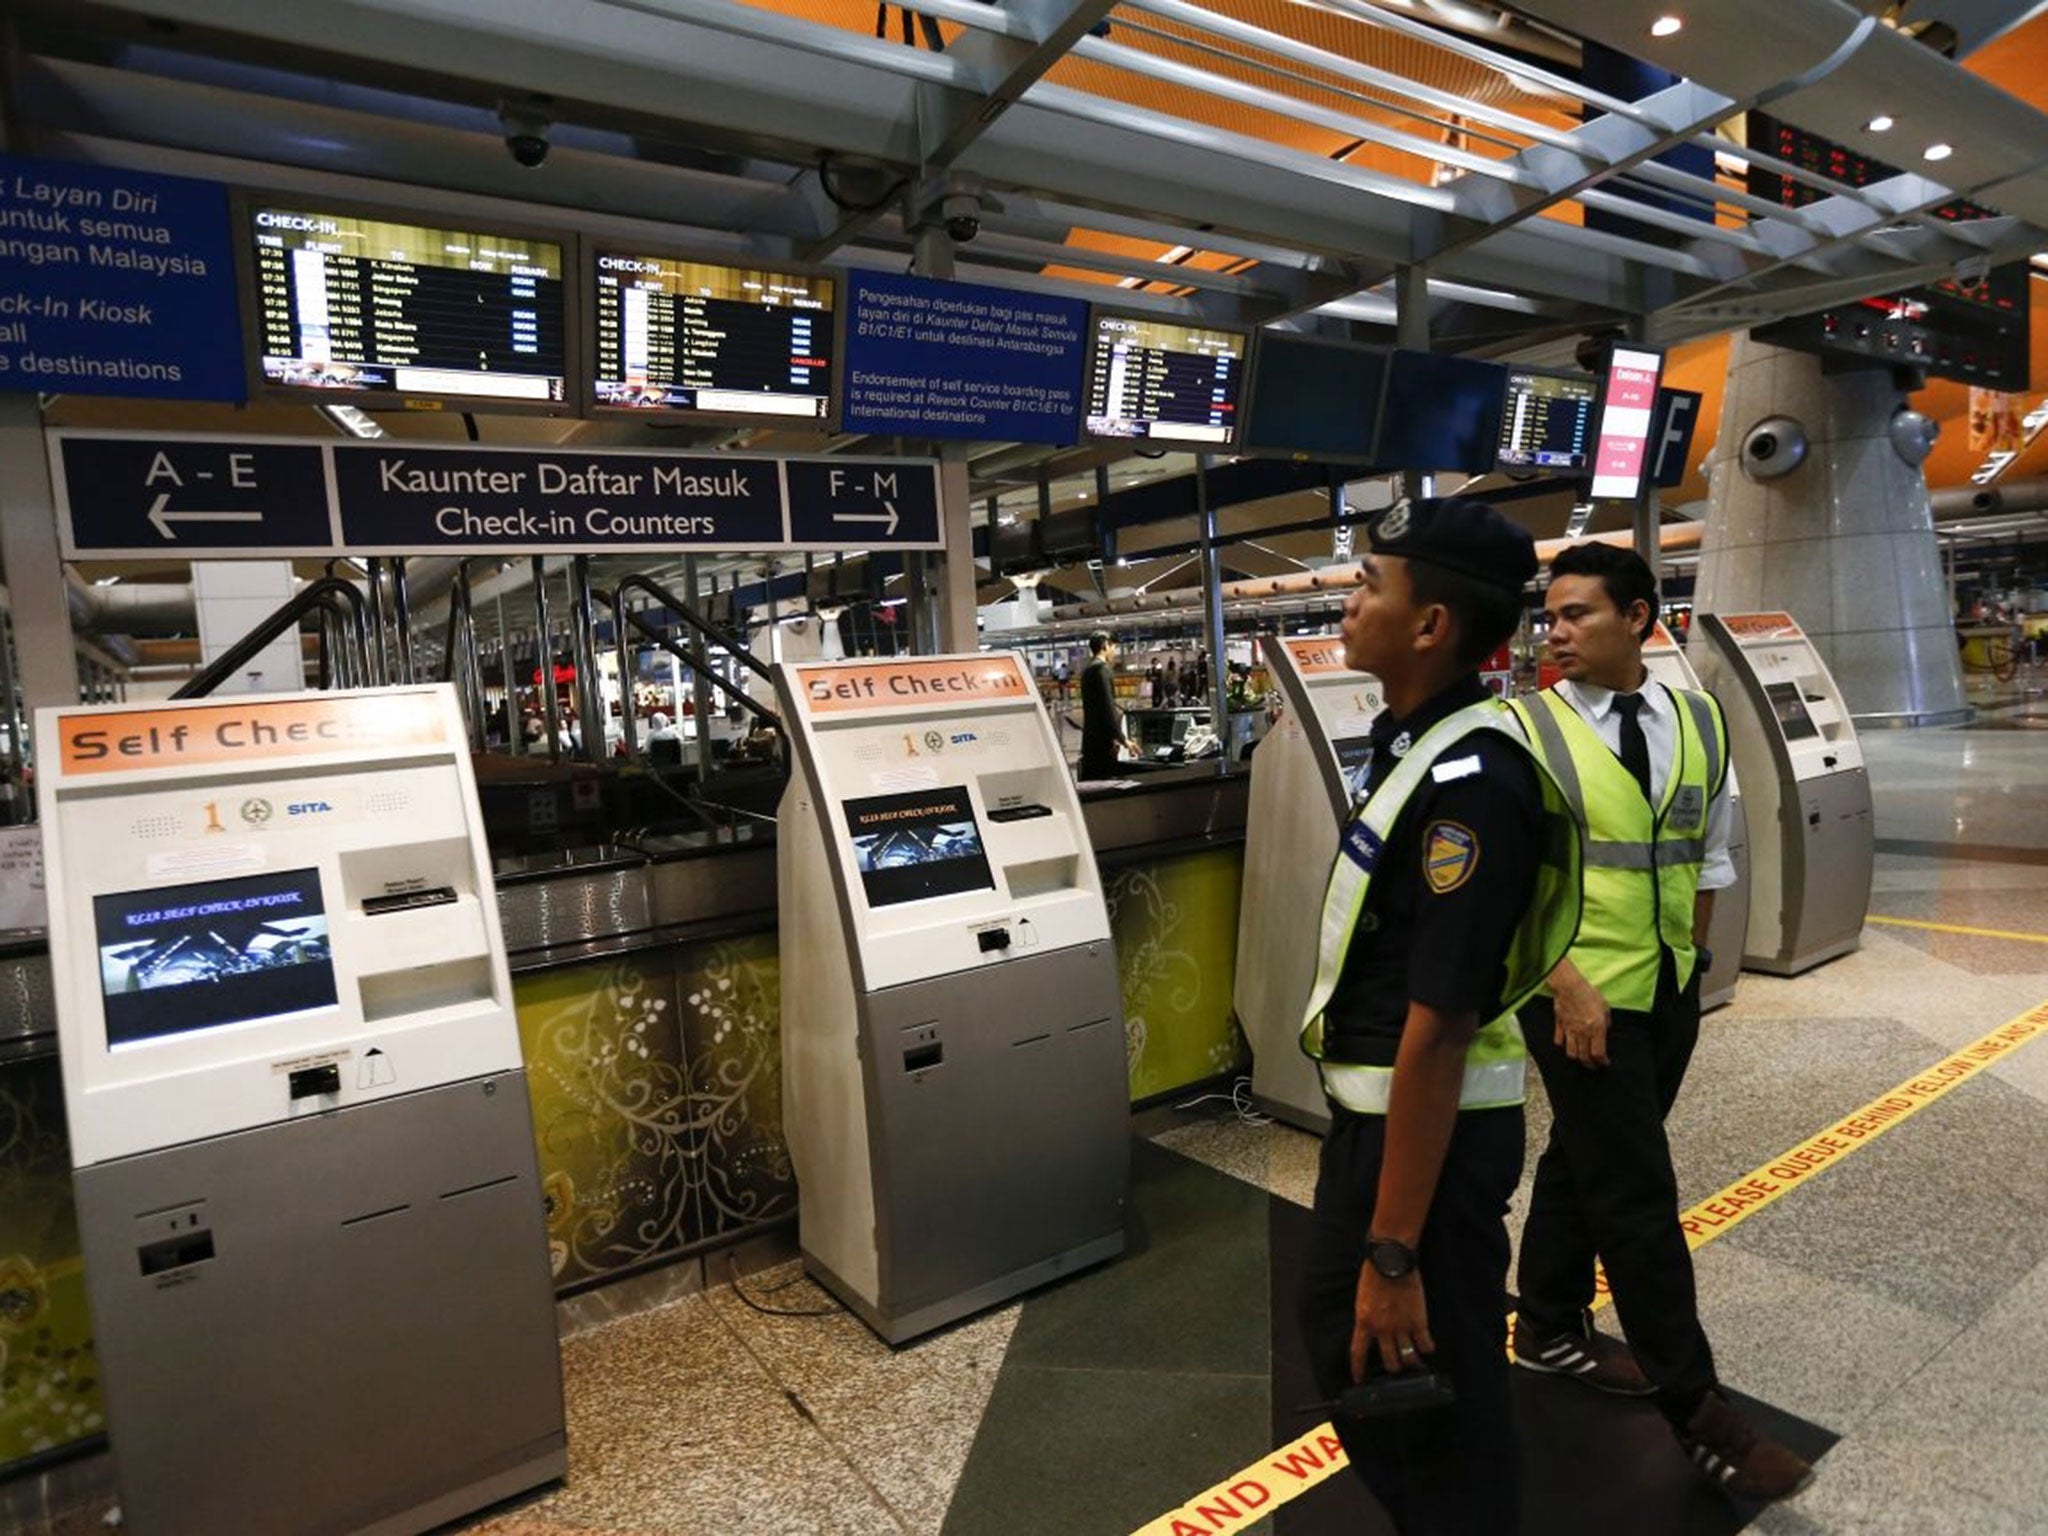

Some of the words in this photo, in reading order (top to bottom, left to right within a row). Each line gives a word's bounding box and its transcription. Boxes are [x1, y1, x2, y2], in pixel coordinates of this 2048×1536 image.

[16, 177, 102, 207] Layan
[112, 190, 158, 213] Diri
[80, 218, 171, 244] semua
[256, 213, 338, 234] CHECK-IN
[89, 244, 207, 276] Malaysia
[599, 257, 660, 274] CHECK-IN
[80, 299, 152, 325] Kiosk
[0, 323, 27, 341] all
[20, 351, 183, 381] destinations
[852, 371, 927, 389] Endorsement
[929, 378, 941, 390] of
[864, 390, 911, 404] required
[913, 393, 924, 404] at
[1653, 396, 1691, 478] F
[146, 452, 182, 486] A
[230, 454, 257, 487] E
[379, 459, 527, 494] Kaunter
[538, 462, 643, 495] Daftar
[653, 466, 751, 498] Masuk
[830, 470, 845, 497] F
[873, 472, 899, 501] M
[435, 507, 576, 536] Check-in
[585, 508, 715, 537] Counters
[808, 675, 876, 701] Self
[889, 671, 1018, 695] Check-in
[72, 725, 189, 761] Self
[950, 732, 978, 745] SITA
[287, 801, 332, 816] SITA
[1681, 1178, 1780, 1236] PLEASE
[1768, 1136, 1850, 1180] QUEUE
[1834, 1097, 1914, 1140] BEHIND
[1901, 1058, 1976, 1098] YELLOW
[1963, 1040, 2010, 1062] LINE
[1170, 1480, 1271, 1536] AND
[1271, 1434, 1343, 1481] WA
